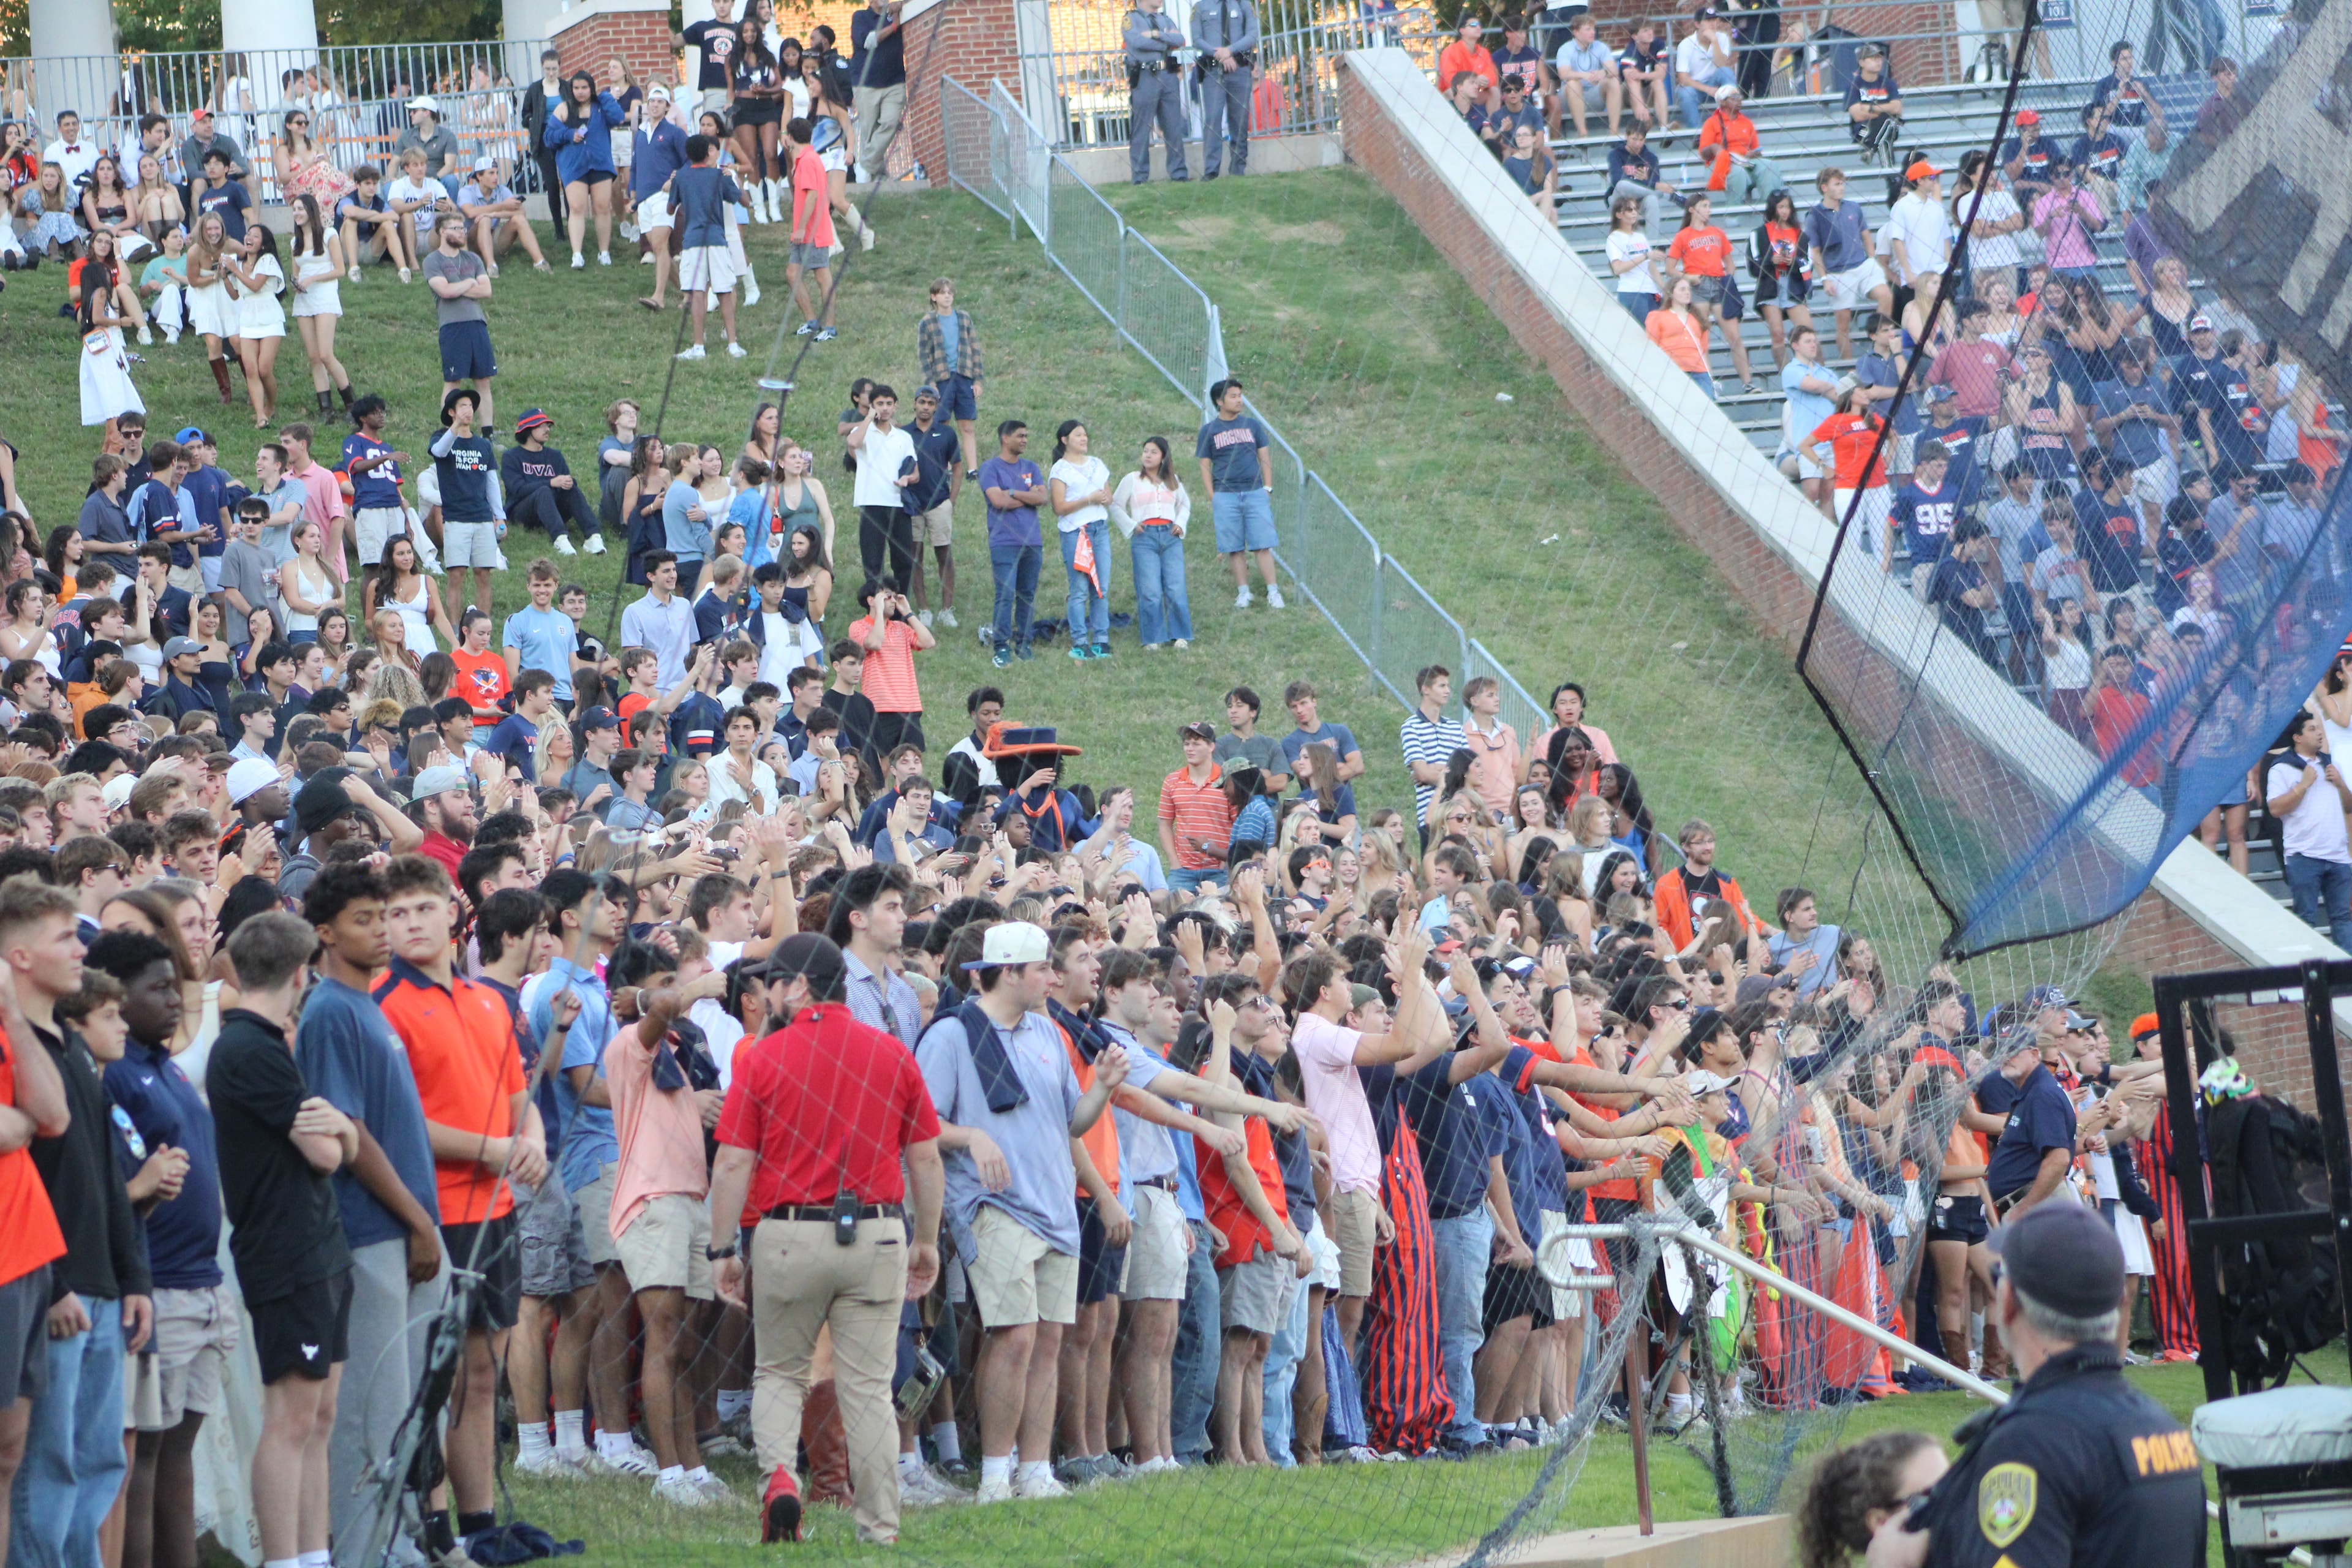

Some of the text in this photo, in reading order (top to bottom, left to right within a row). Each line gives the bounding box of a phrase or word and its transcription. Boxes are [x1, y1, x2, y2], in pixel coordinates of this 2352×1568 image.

[2049, 6, 2065, 17] 101
[1689, 236, 1722, 251] VIRGINIA
[1213, 429, 1254, 450] VIRGINIA
[451, 449, 483, 458] VIRGINIA
[522, 462, 556, 477] UVA
[1915, 503, 1954, 535] 95
[2131, 1430, 2199, 1477] POLICE
